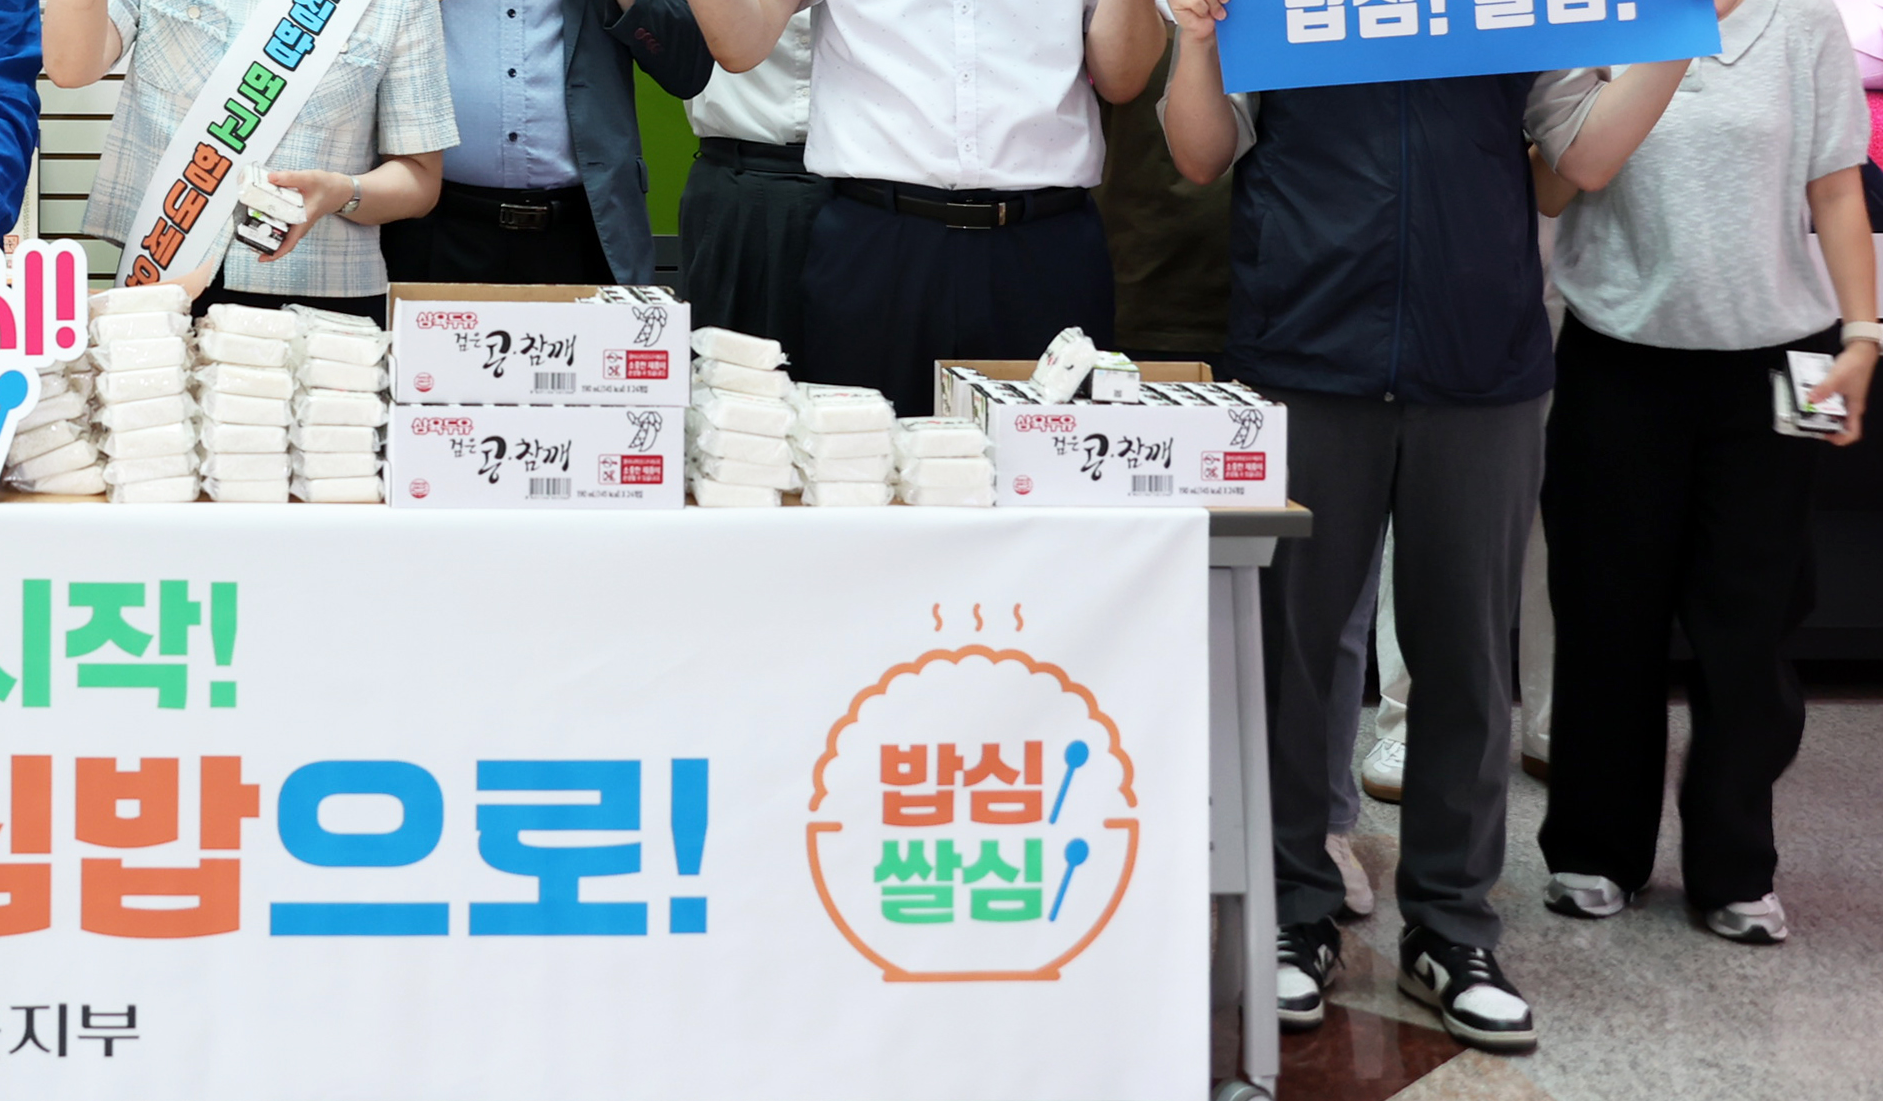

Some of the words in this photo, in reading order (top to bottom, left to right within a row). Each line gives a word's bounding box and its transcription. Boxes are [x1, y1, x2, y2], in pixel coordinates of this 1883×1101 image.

[206, 60, 288, 155] 먹고
[416, 311, 478, 330] 삼육두유
[454, 333, 481, 351] 검은
[411, 417, 474, 436] 삼육두유
[1015, 414, 1077, 433] 삼육두유
[449, 438, 477, 458] 검은
[1052, 435, 1079, 456] 검은
